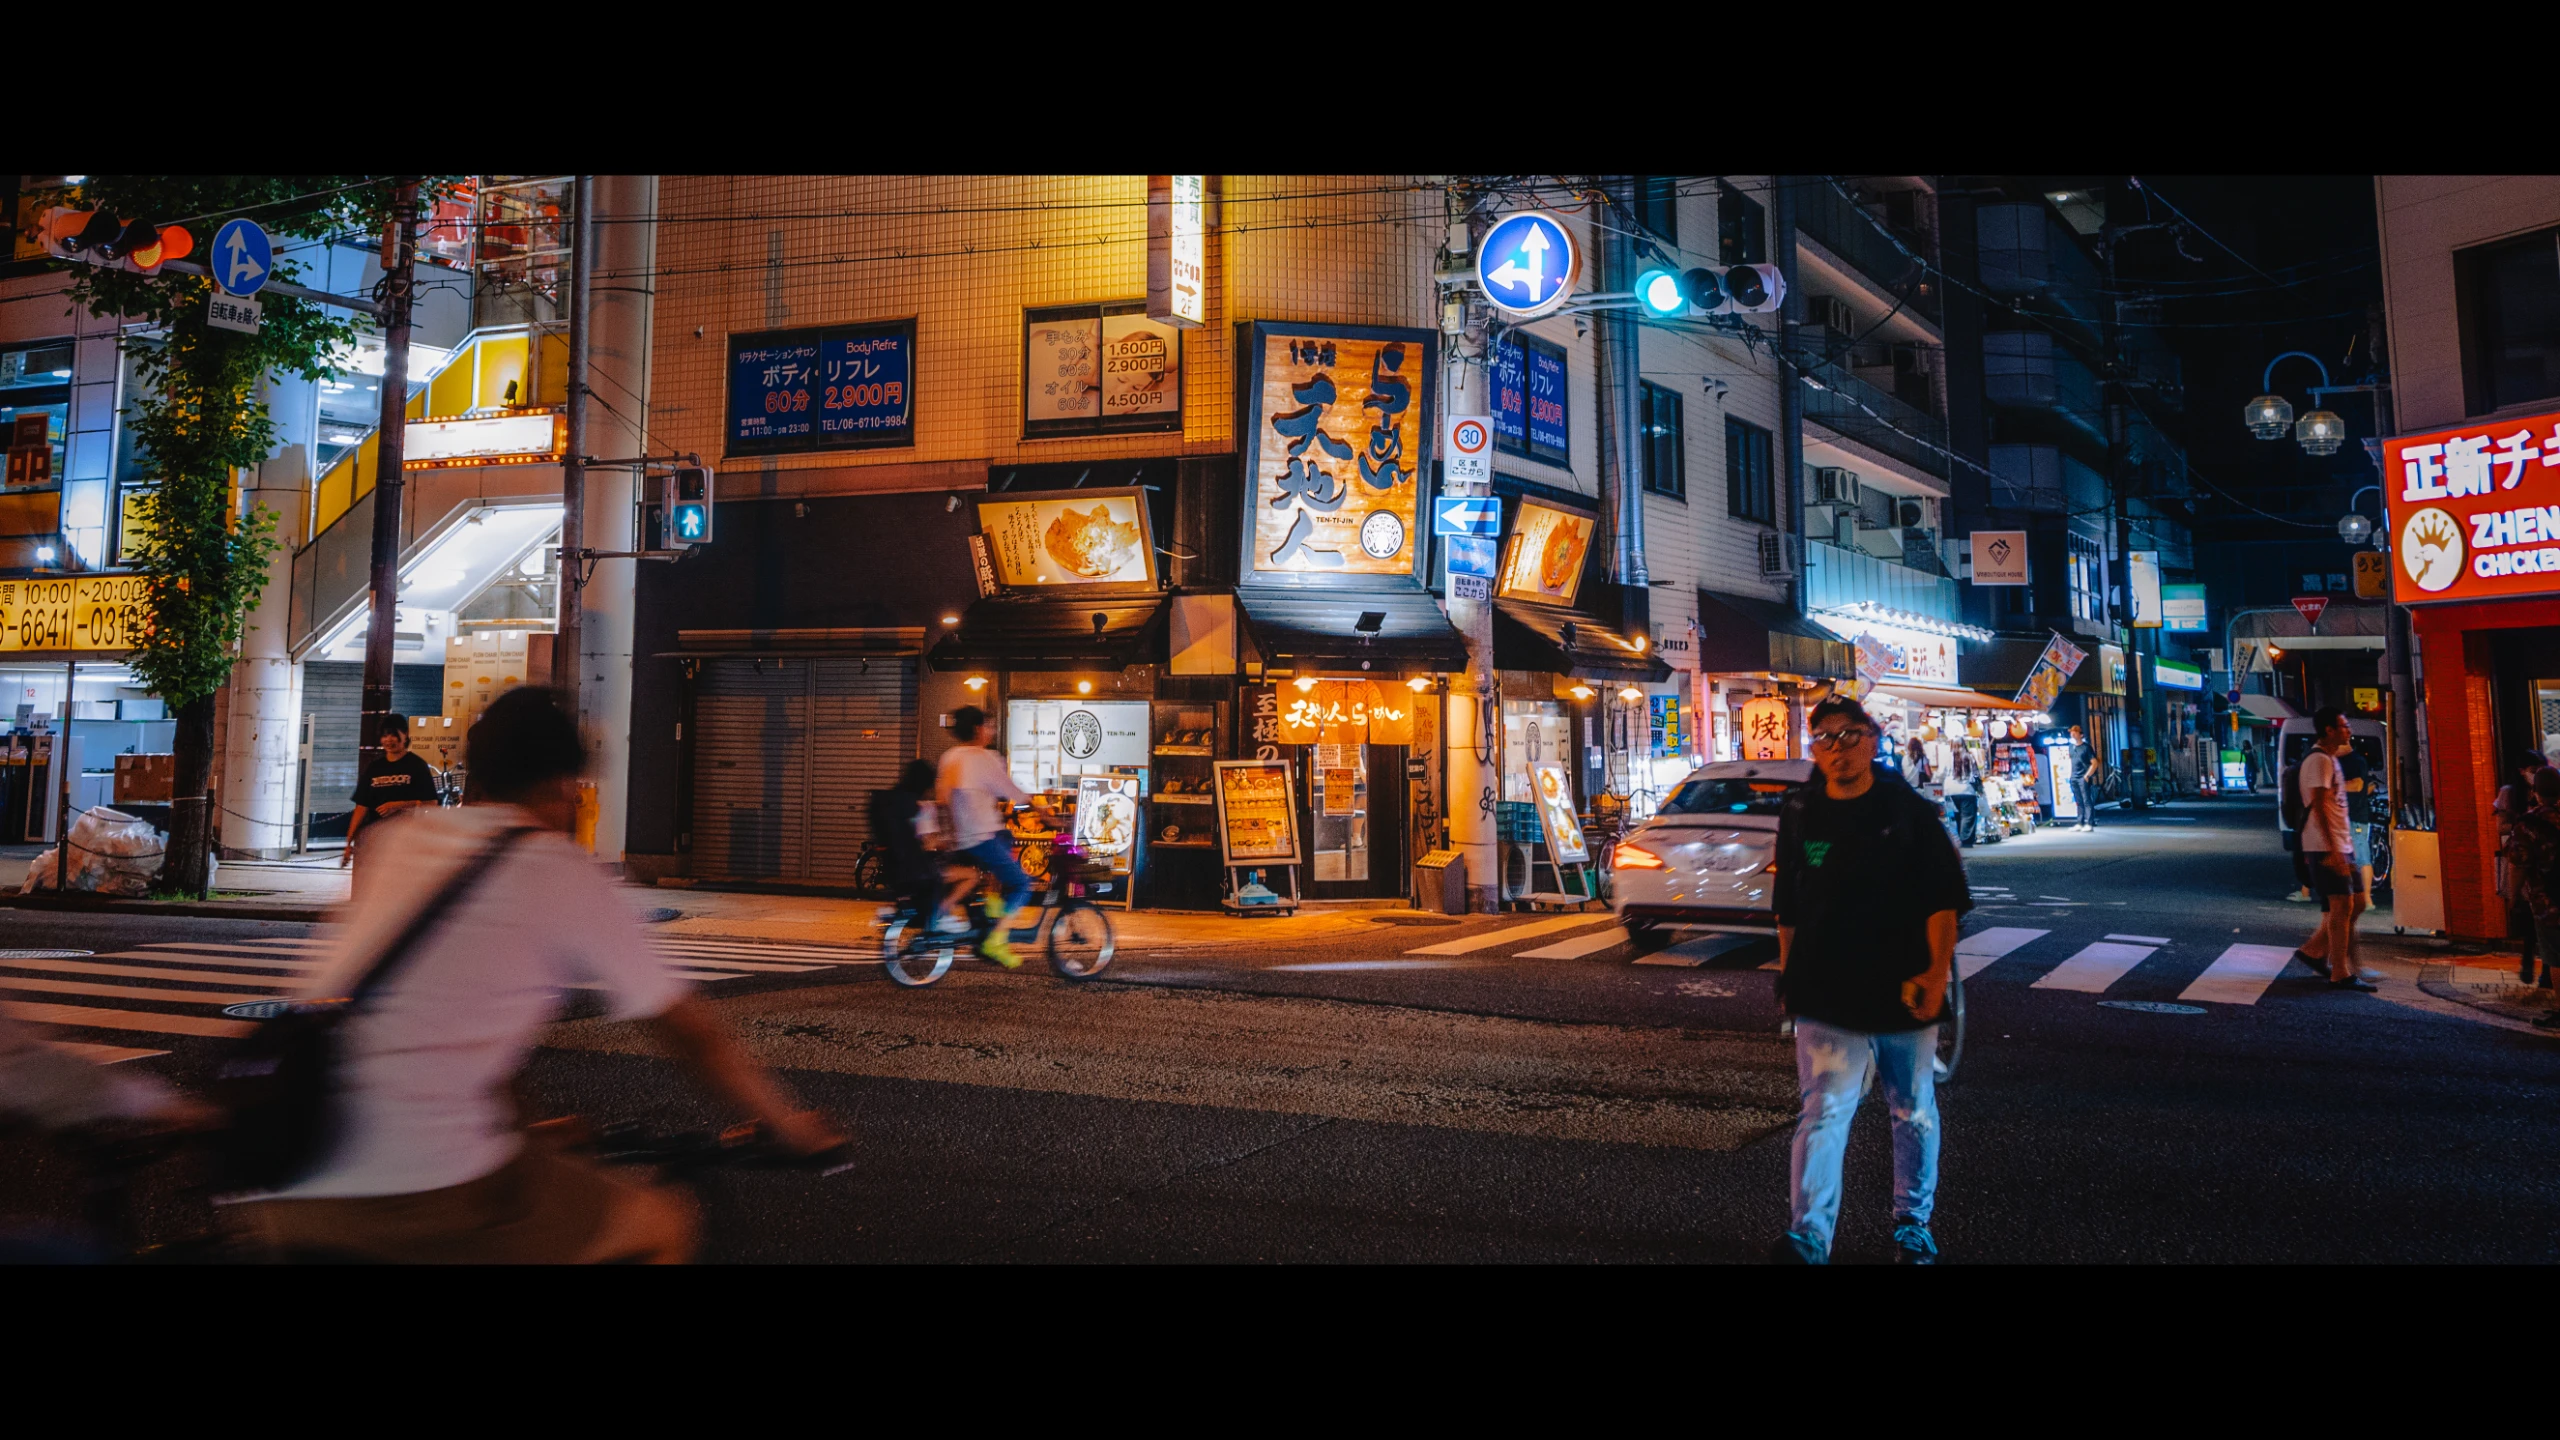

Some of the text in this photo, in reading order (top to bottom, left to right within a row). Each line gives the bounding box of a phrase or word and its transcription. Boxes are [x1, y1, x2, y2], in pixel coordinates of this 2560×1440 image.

[210, 301, 258, 326] 自転車を除く
[1045, 329, 1090, 346] 手もみ
[739, 347, 818, 364] リラクゼーションサロン
[847, 339, 898, 356] Body Refre
[1058, 346, 1091, 361] 30分
[1109, 340, 1163, 357] 1,600円
[1058, 362, 1091, 378] 60分
[1107, 357, 1163, 373] 2,900円
[824, 381, 903, 410] 2,900円
[1045, 380, 1089, 395] オイル
[765, 389, 811, 414] 60分
[1057, 397, 1091, 411] 60分
[1107, 391, 1163, 407] 4,500円
[1358, 341, 1415, 490] らーめん
[1531, 395, 1563, 427] 2,900円
[741, 417, 767, 427] 営業時間
[788, 423, 810, 434] 23:00
[1460, 429, 1479, 445] 30
[1270, 372, 1354, 566] 天地人
[1452, 466, 1484, 477] ここから
[1315, 516, 1354, 525] TEN-TI-JIN
[2474, 548, 2560, 578] CHICKE
[1456, 578, 1486, 588] 自転車を除く
[0, 584, 15, 606] 間
[25, 583, 72, 605] 10:00
[1455, 587, 1486, 599] ここから
[2301, 603, 2322, 612] 止まれ
[26, 688, 36, 698] 12
[1285, 699, 1406, 729] 天地人 らーめん
[1253, 693, 1279, 762] 至極の
[1666, 698, 1679, 758] 高価買取
